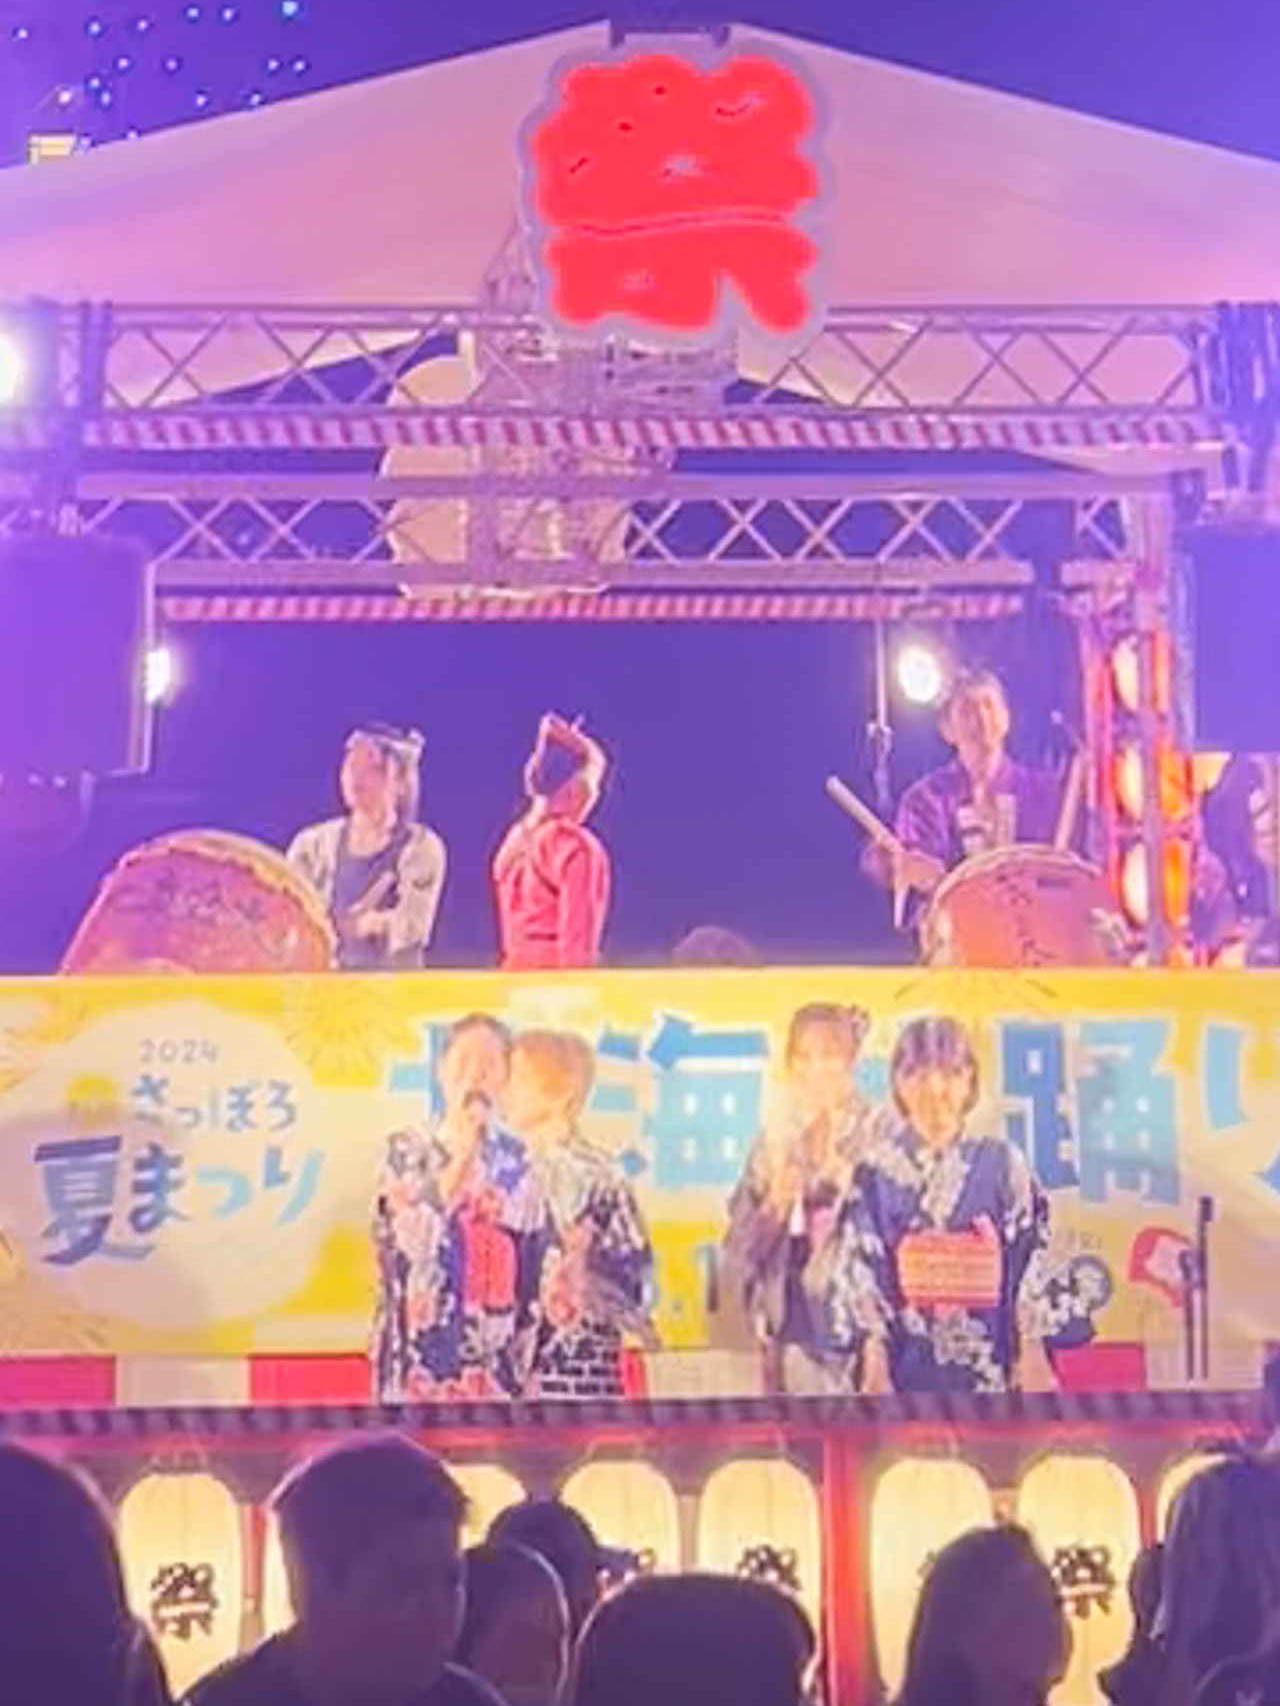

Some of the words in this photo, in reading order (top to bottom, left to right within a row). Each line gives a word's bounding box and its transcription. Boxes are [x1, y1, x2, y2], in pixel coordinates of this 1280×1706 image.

[140, 1039, 219, 1063] 2024
[131, 1073, 297, 1132] さっぽろ
[33, 1134, 326, 1265] 夏まつり
[150, 1562, 218, 1642] 祭
